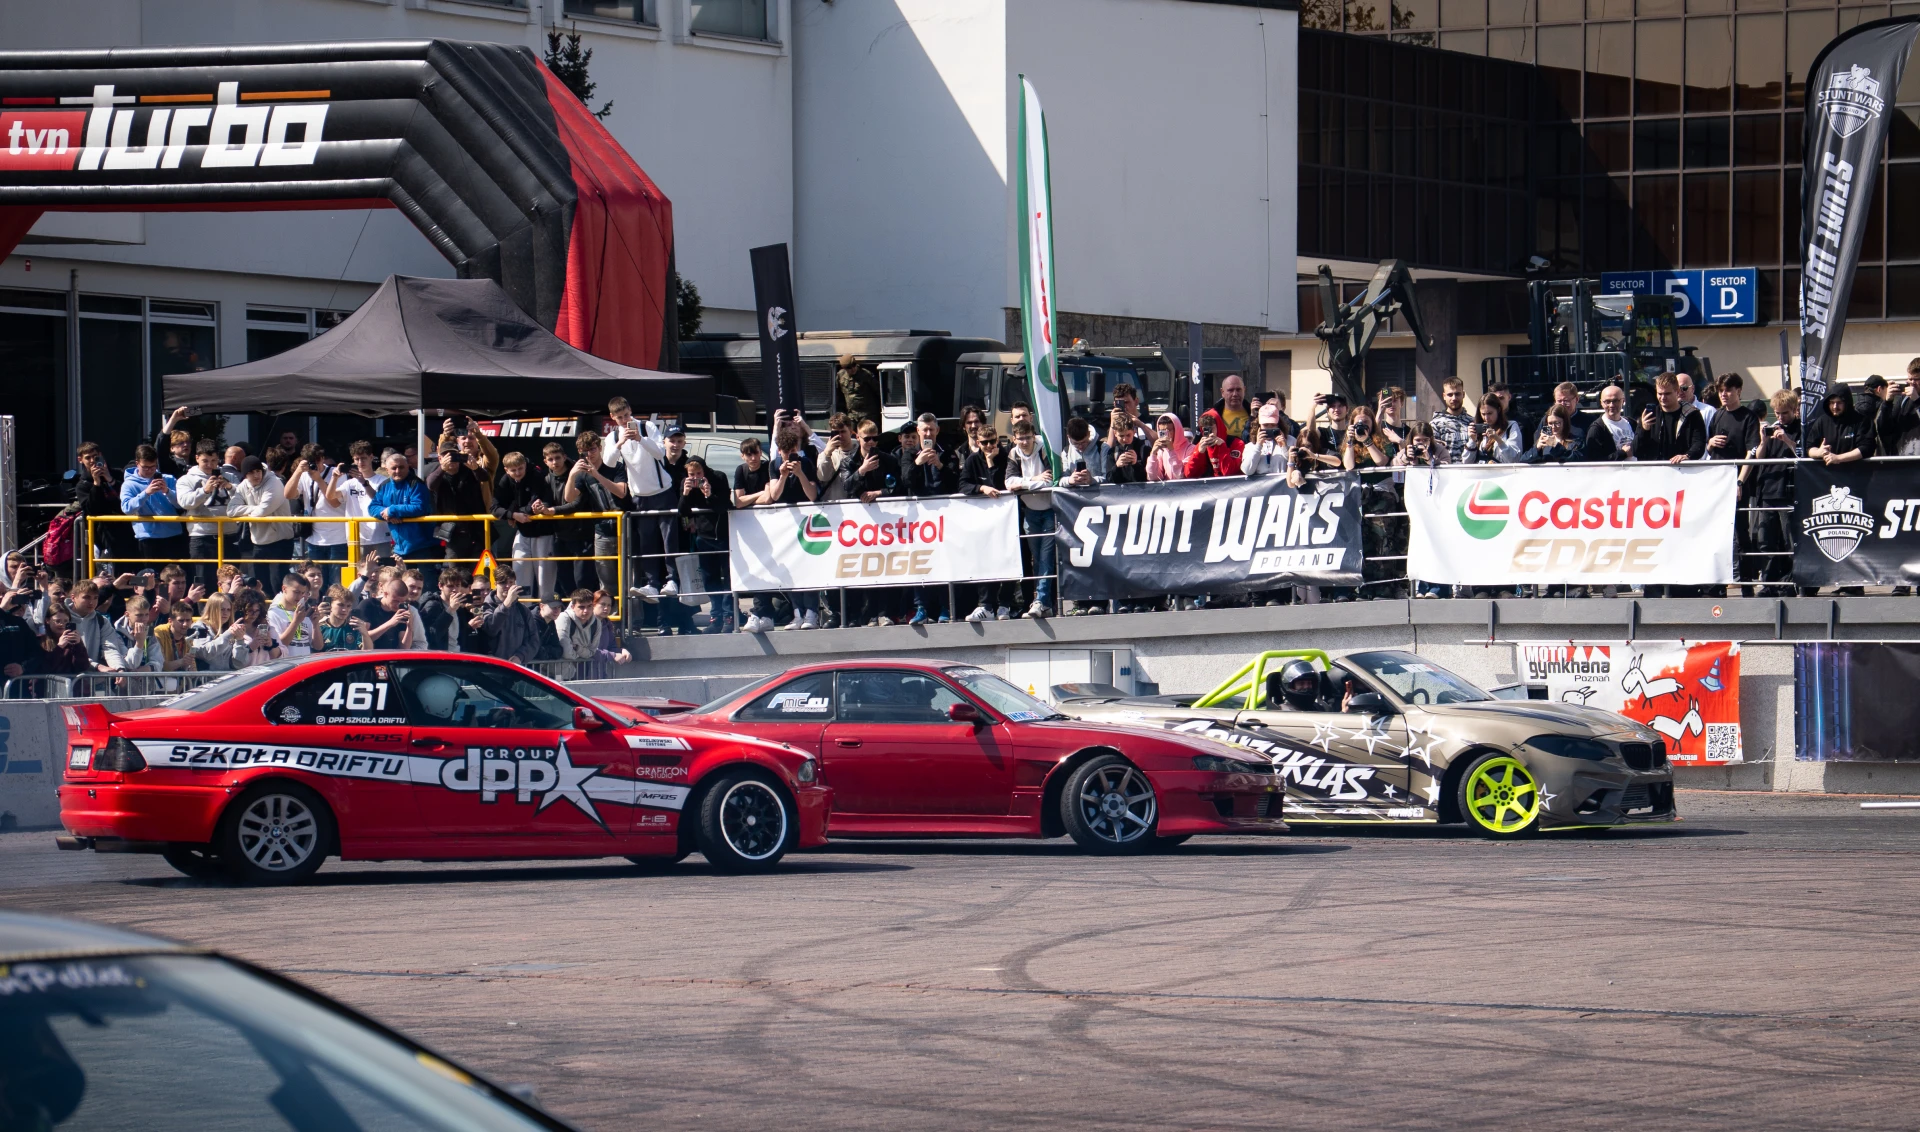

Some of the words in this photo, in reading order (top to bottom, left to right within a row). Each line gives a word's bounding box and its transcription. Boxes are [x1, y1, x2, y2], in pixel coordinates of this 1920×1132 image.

[1818, 90, 1854, 102] STUNT
[1854, 93, 1885, 112] WARS
[8, 121, 70, 155] tvn
[60, 82, 330, 170] turbo
[1816, 151, 1854, 248] STUNT
[1610, 280, 1645, 289] SEKTOR
[1710, 276, 1747, 286] SEKTOR
[1805, 243, 1837, 339] WARS
[1665, 278, 1690, 318] 5
[1720, 287, 1737, 310] D
[1518, 490, 1685, 530] Castrol
[1802, 513, 1839, 529] STUNT
[1841, 513, 1875, 529] WARS
[837, 515, 944, 547] Castrol
[1069, 499, 1202, 566] STUNT
[1203, 492, 1345, 563] WARS
[836, 550, 933, 578] EDGE
[1258, 553, 1337, 569] POLAND
[1512, 538, 1663, 573] EDGE
[1526, 647, 1568, 662] MOTO
[1529, 658, 1610, 679] gymkhana
[1574, 674, 1610, 682] Poznań
[318, 682, 388, 710] 461
[328, 716, 344, 724] DPP
[345, 716, 376, 724] SZKOŁA
[169, 745, 294, 766] SZKOŁA
[296, 750, 405, 776] DRIFTU
[484, 748, 555, 760] GROUP
[441, 748, 557, 803] dpp
[636, 767, 688, 777] GRAFICON
